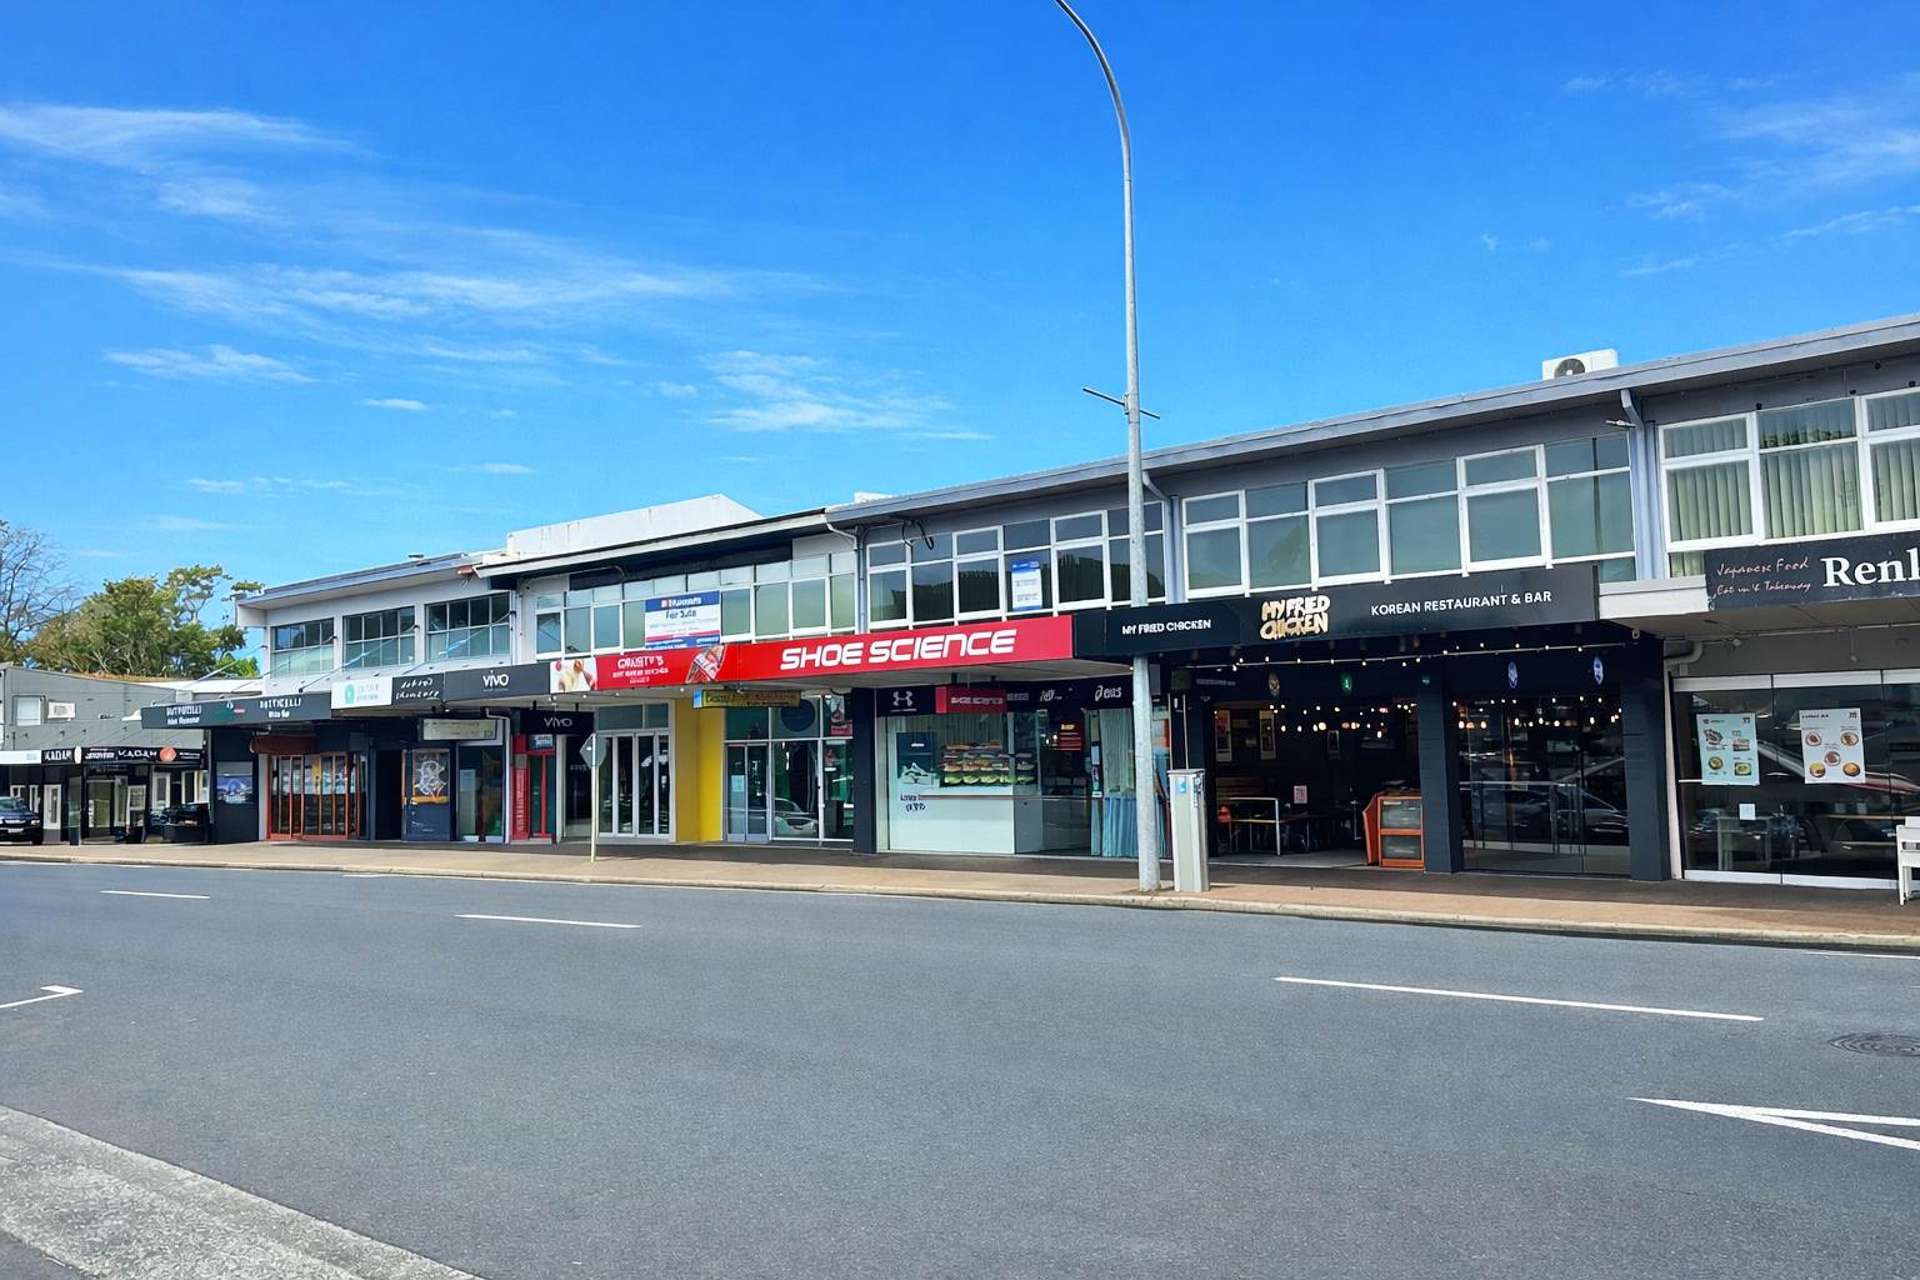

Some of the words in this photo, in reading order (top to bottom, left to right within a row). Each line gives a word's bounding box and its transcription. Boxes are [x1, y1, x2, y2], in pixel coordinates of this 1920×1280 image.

[1716, 562, 1772, 578] Japanese
[1776, 556, 1809, 573] Food
[1717, 583, 1735, 596] Eat
[1765, 580, 1811, 593] Takeaway
[1261, 600, 1286, 621] MY
[1286, 595, 1331, 618] FRIED
[1370, 600, 1421, 616] KOREAN
[1424, 594, 1508, 612] RESTAURANT
[1511, 594, 1521, 605] &
[1524, 591, 1552, 603] BAR
[1122, 624, 1137, 635] MY
[1260, 612, 1329, 640] CHICKEN
[780, 642, 864, 671] SHOE
[869, 629, 1017, 663] SCIENCE
